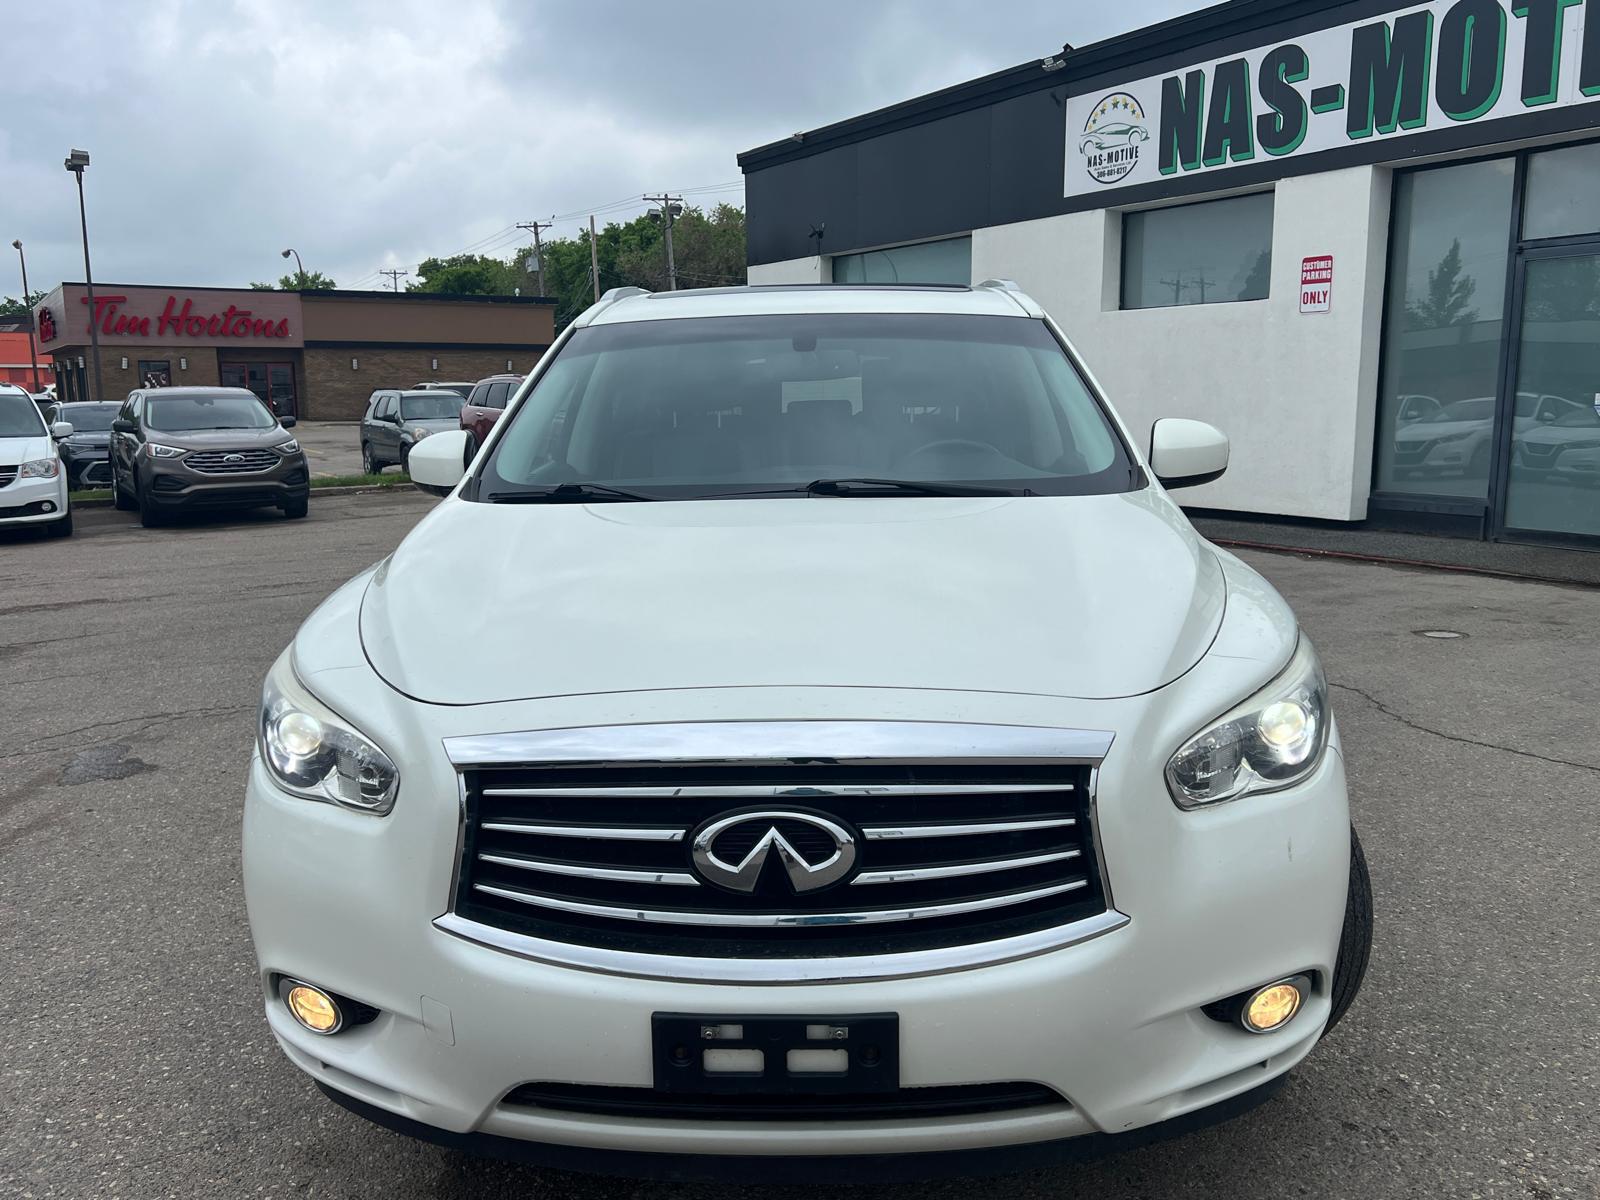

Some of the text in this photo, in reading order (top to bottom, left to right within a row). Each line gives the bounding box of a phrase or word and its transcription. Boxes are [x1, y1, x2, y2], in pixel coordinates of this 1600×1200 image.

[1087, 145, 1139, 168] NAS-MOTIVE
[1303, 269, 1331, 281] PARKING
[1303, 290, 1328, 305] ONLY
[81, 296, 290, 337] Tim Hortons
